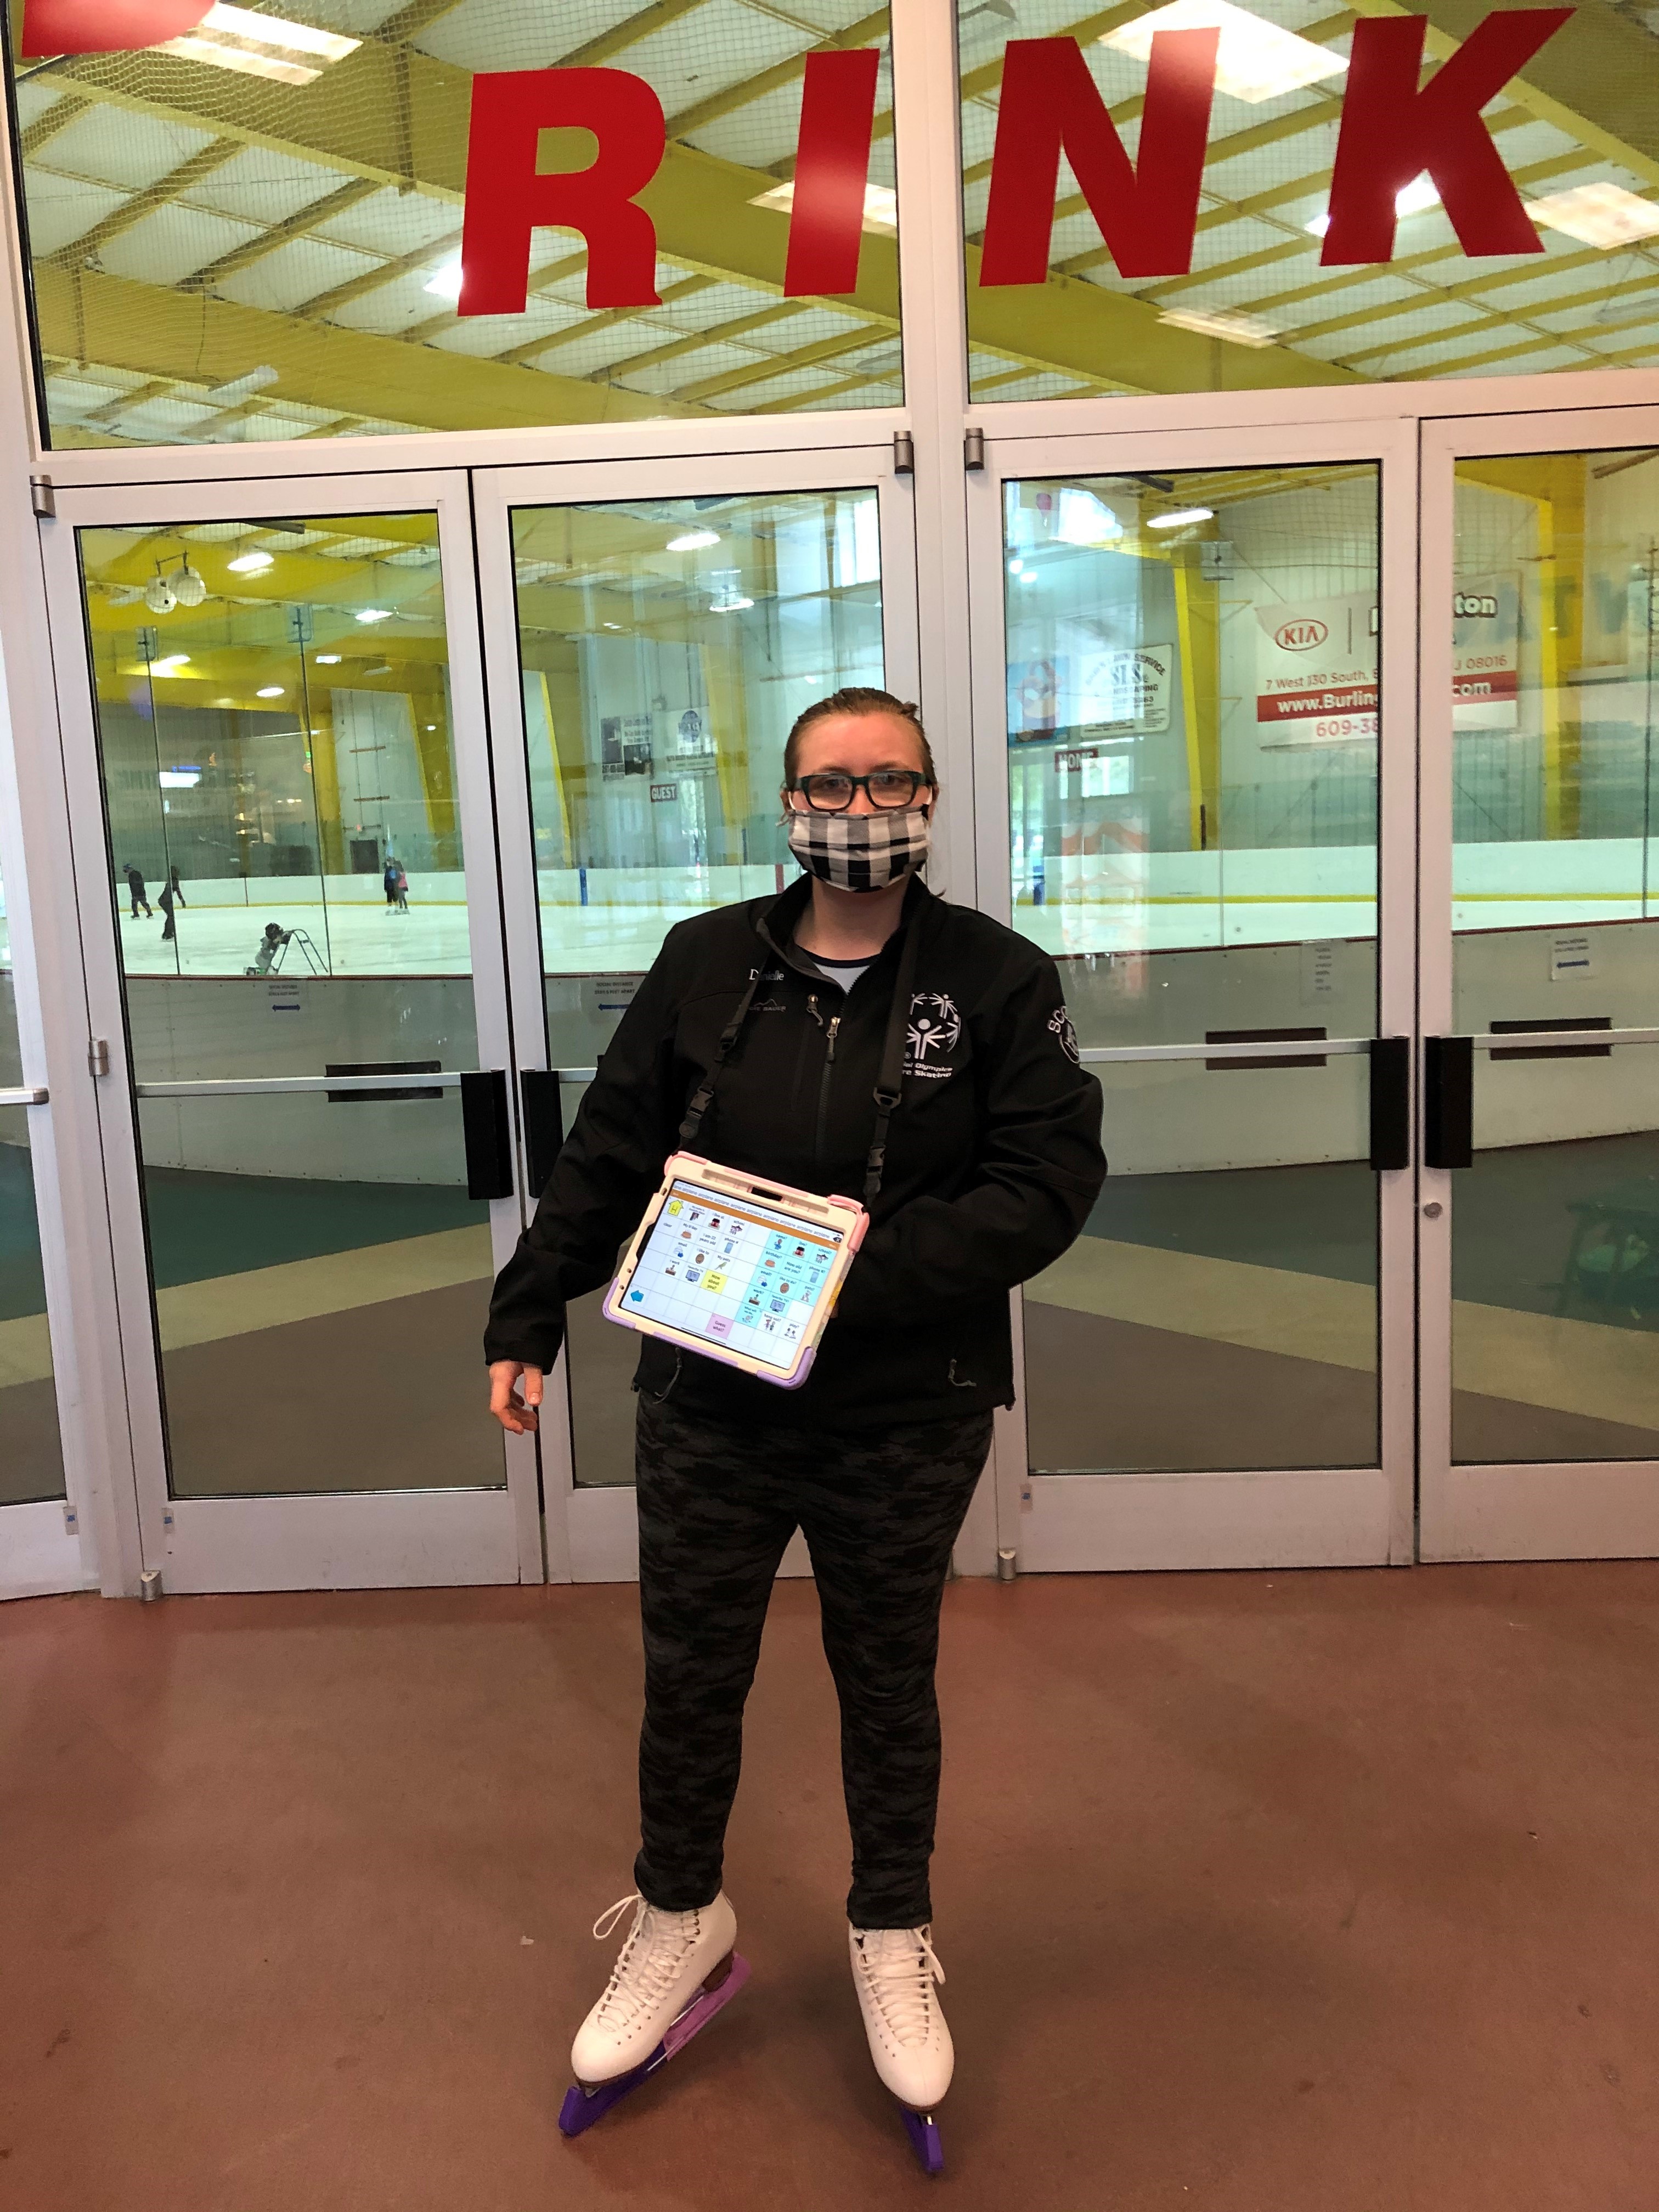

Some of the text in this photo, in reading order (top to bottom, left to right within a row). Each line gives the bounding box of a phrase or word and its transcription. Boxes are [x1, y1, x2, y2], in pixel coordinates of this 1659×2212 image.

[458, 8, 1577, 317] RINK
[1453, 592, 1498, 618] ton
[1284, 625, 1319, 645] KIA
[1276, 676, 1304, 689] West
[1307, 674, 1327, 686] 130
[1331, 670, 1369, 683] South,
[1454, 659, 1462, 670] J
[1466, 656, 1508, 669] 08016
[1452, 682, 1492, 697] com
[652, 786, 676, 800] GUEST
[749, 969, 785, 981] Dnielle
